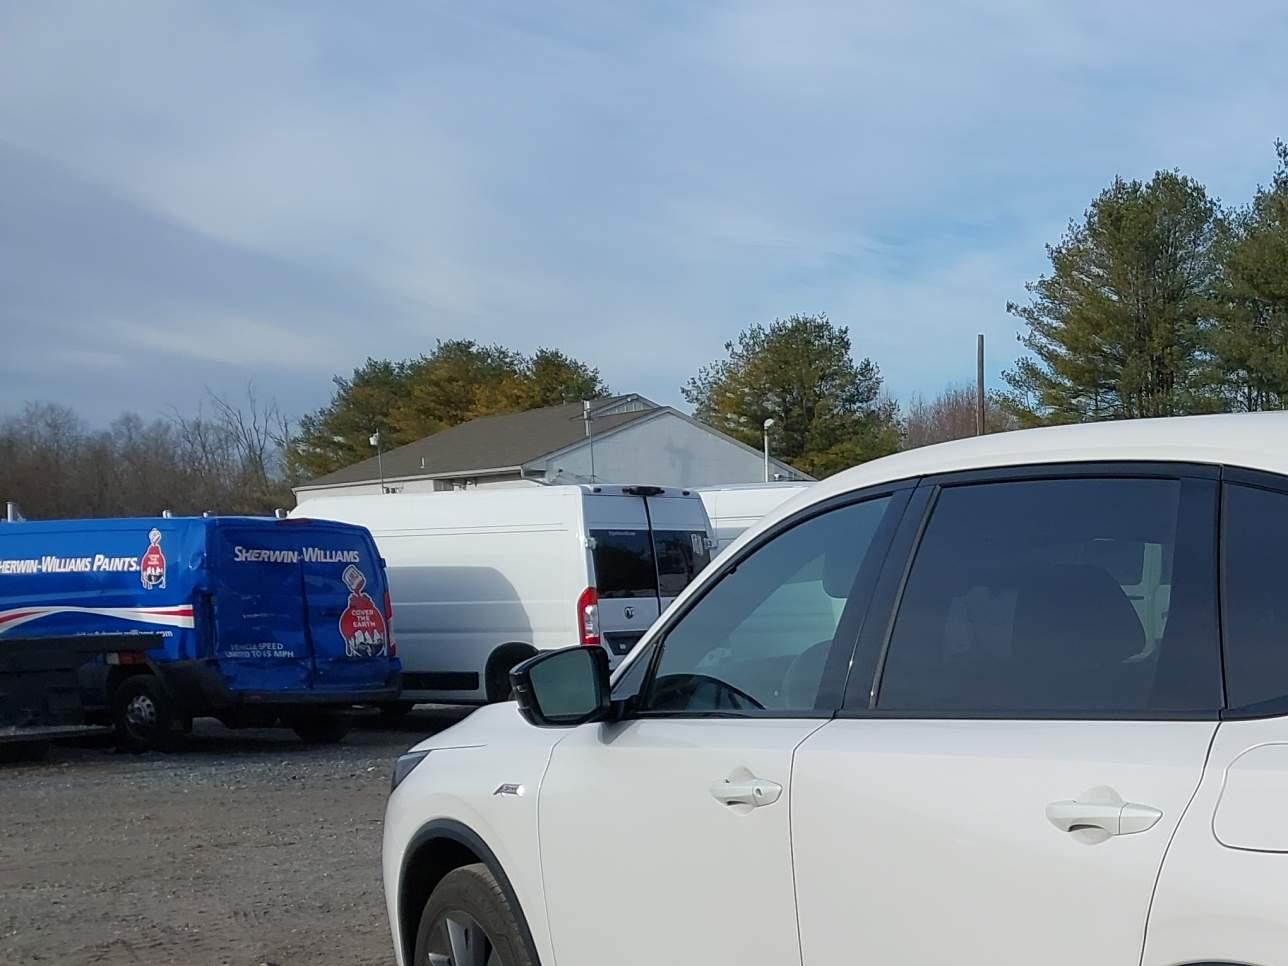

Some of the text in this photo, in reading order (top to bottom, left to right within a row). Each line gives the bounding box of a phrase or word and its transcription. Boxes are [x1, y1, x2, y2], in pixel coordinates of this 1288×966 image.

[234, 546, 360, 563] SHERWIN-WILLIAMS
[258, 642, 284, 650] SPEED
[273, 650, 295, 658] MPH
